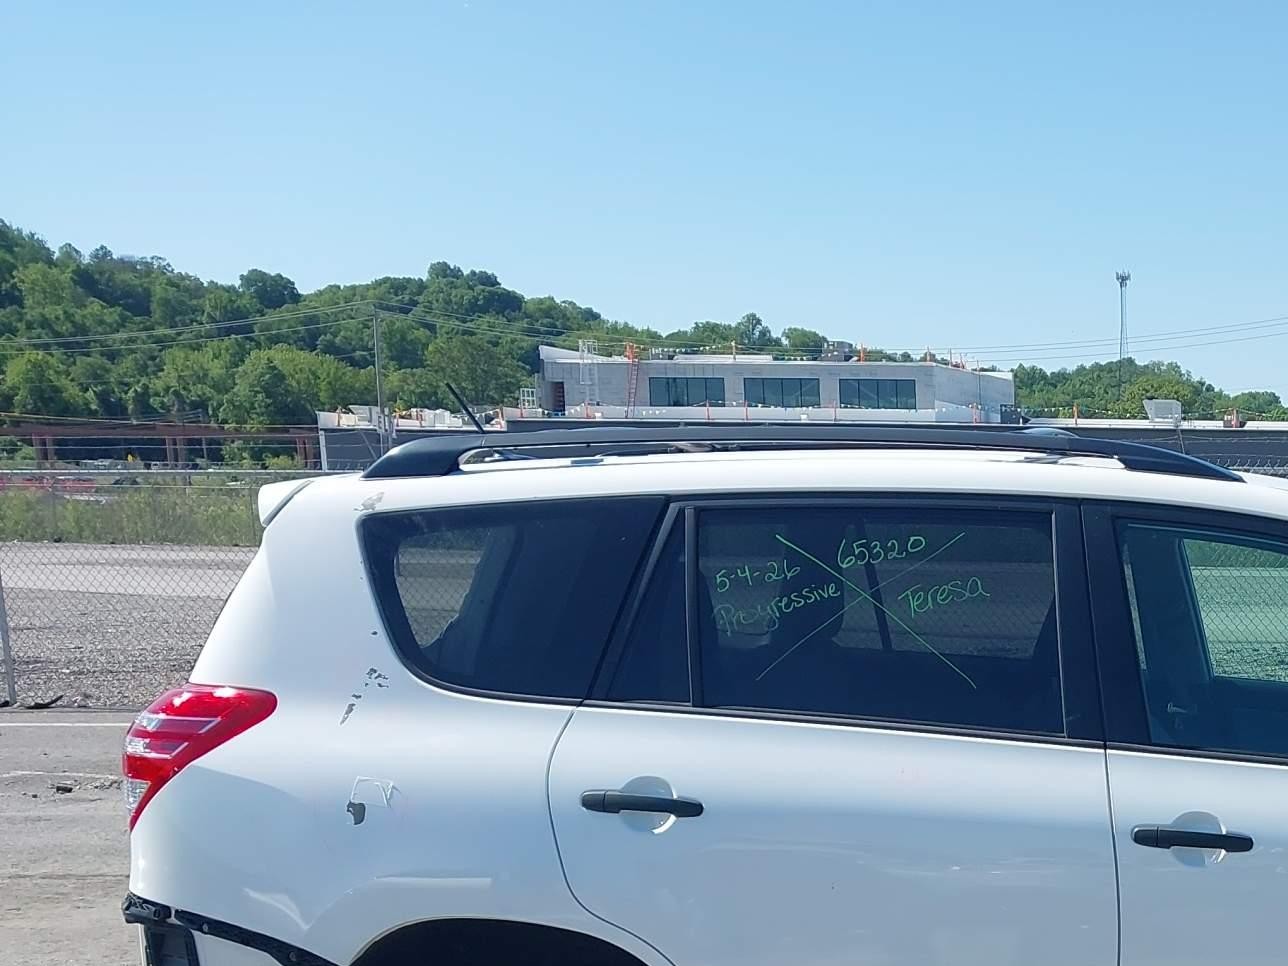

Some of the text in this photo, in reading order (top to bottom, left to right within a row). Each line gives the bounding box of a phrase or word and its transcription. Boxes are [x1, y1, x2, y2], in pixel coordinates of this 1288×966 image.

[837, 536, 926, 568] 65320
[715, 559, 801, 593] 5-4-26
[713, 582, 840, 637] Progressive
[898, 577, 990, 618] Teresa
